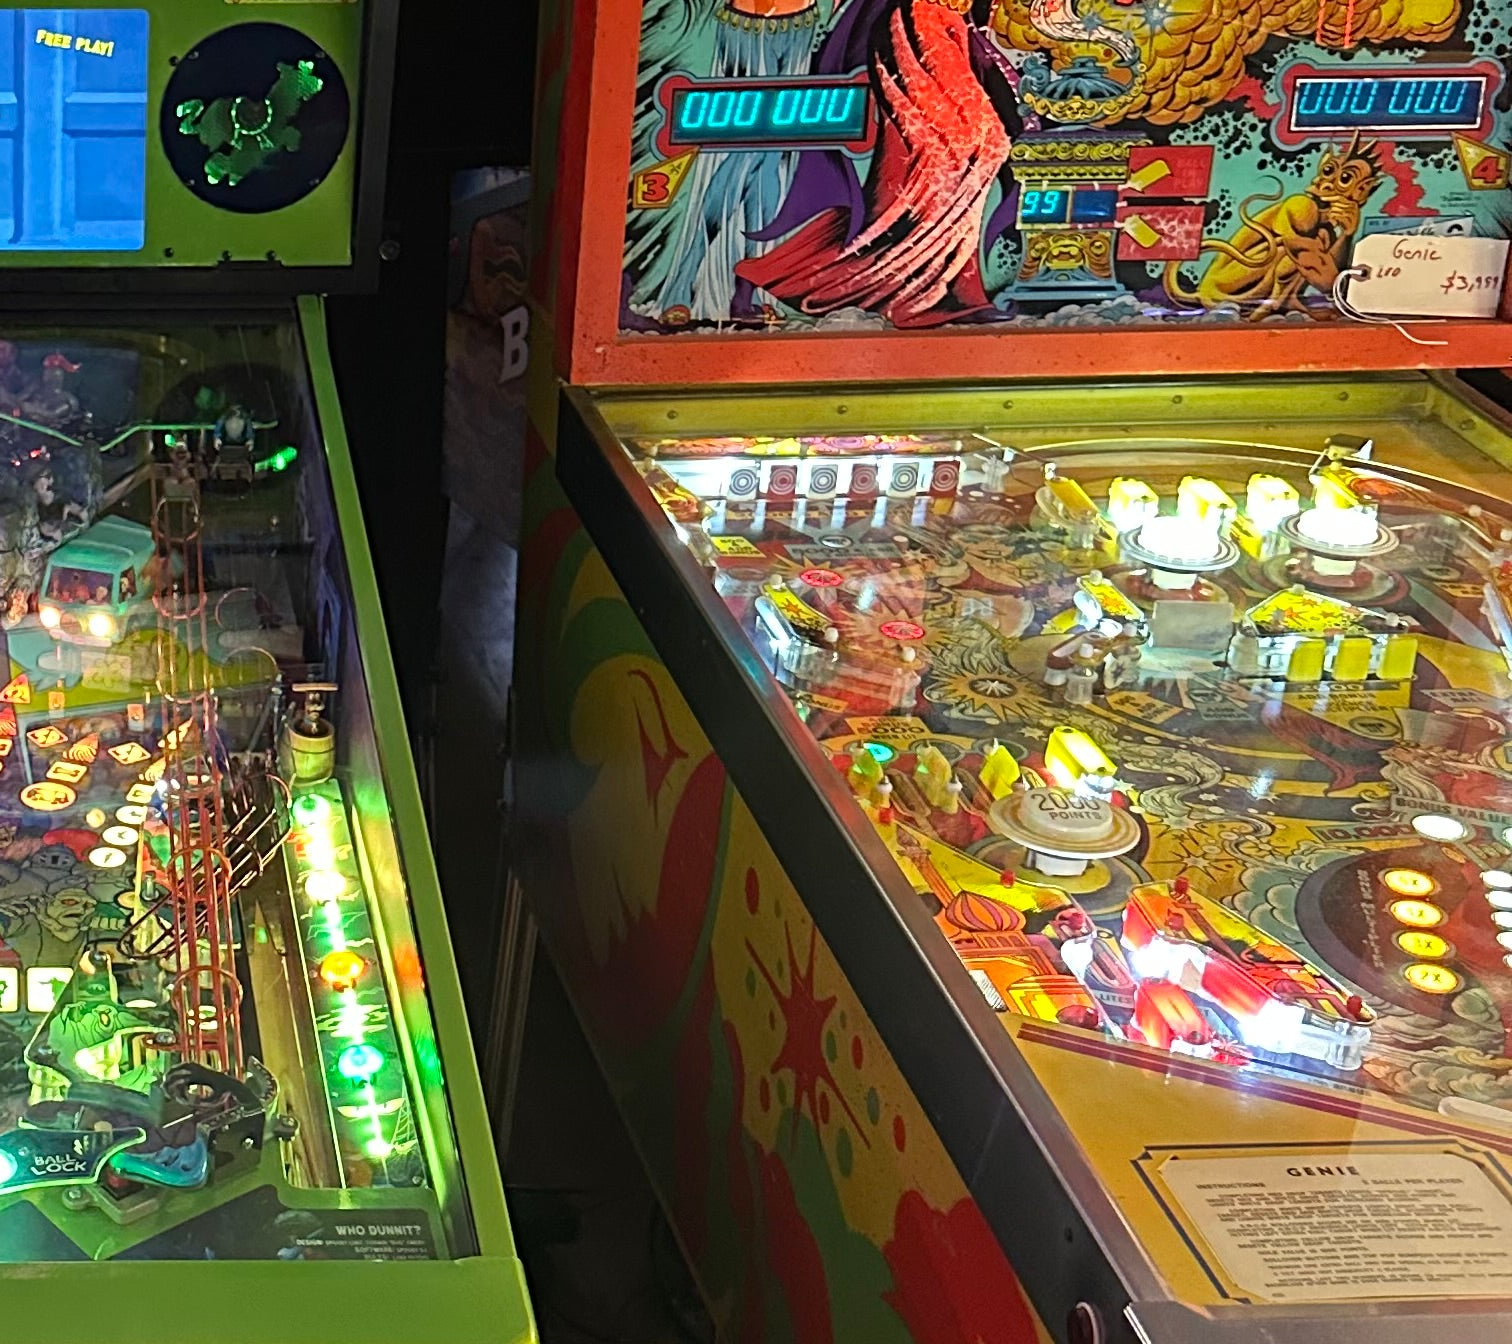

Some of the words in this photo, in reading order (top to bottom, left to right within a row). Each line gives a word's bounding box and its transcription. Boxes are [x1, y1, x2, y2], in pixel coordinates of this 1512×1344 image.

[36, 29, 72, 49] FREE
[75, 37, 115, 58] PLAY!
[1472, 156, 1504, 184] 4
[642, 172, 669, 202] 3
[1022, 191, 1061, 214] 99
[1392, 238, 1443, 261] Genie
[1030, 790, 1100, 814] 2000
[1395, 796, 1447, 813] BONUS
[1048, 810, 1103, 822] POINTS
[30, 1161, 87, 1176] LOCK
[34, 1153, 76, 1167] BALL
[1286, 1166, 1360, 1177] GENIE
[336, 1225, 365, 1236] WHO
[368, 1225, 422, 1236] DUNNIT?
